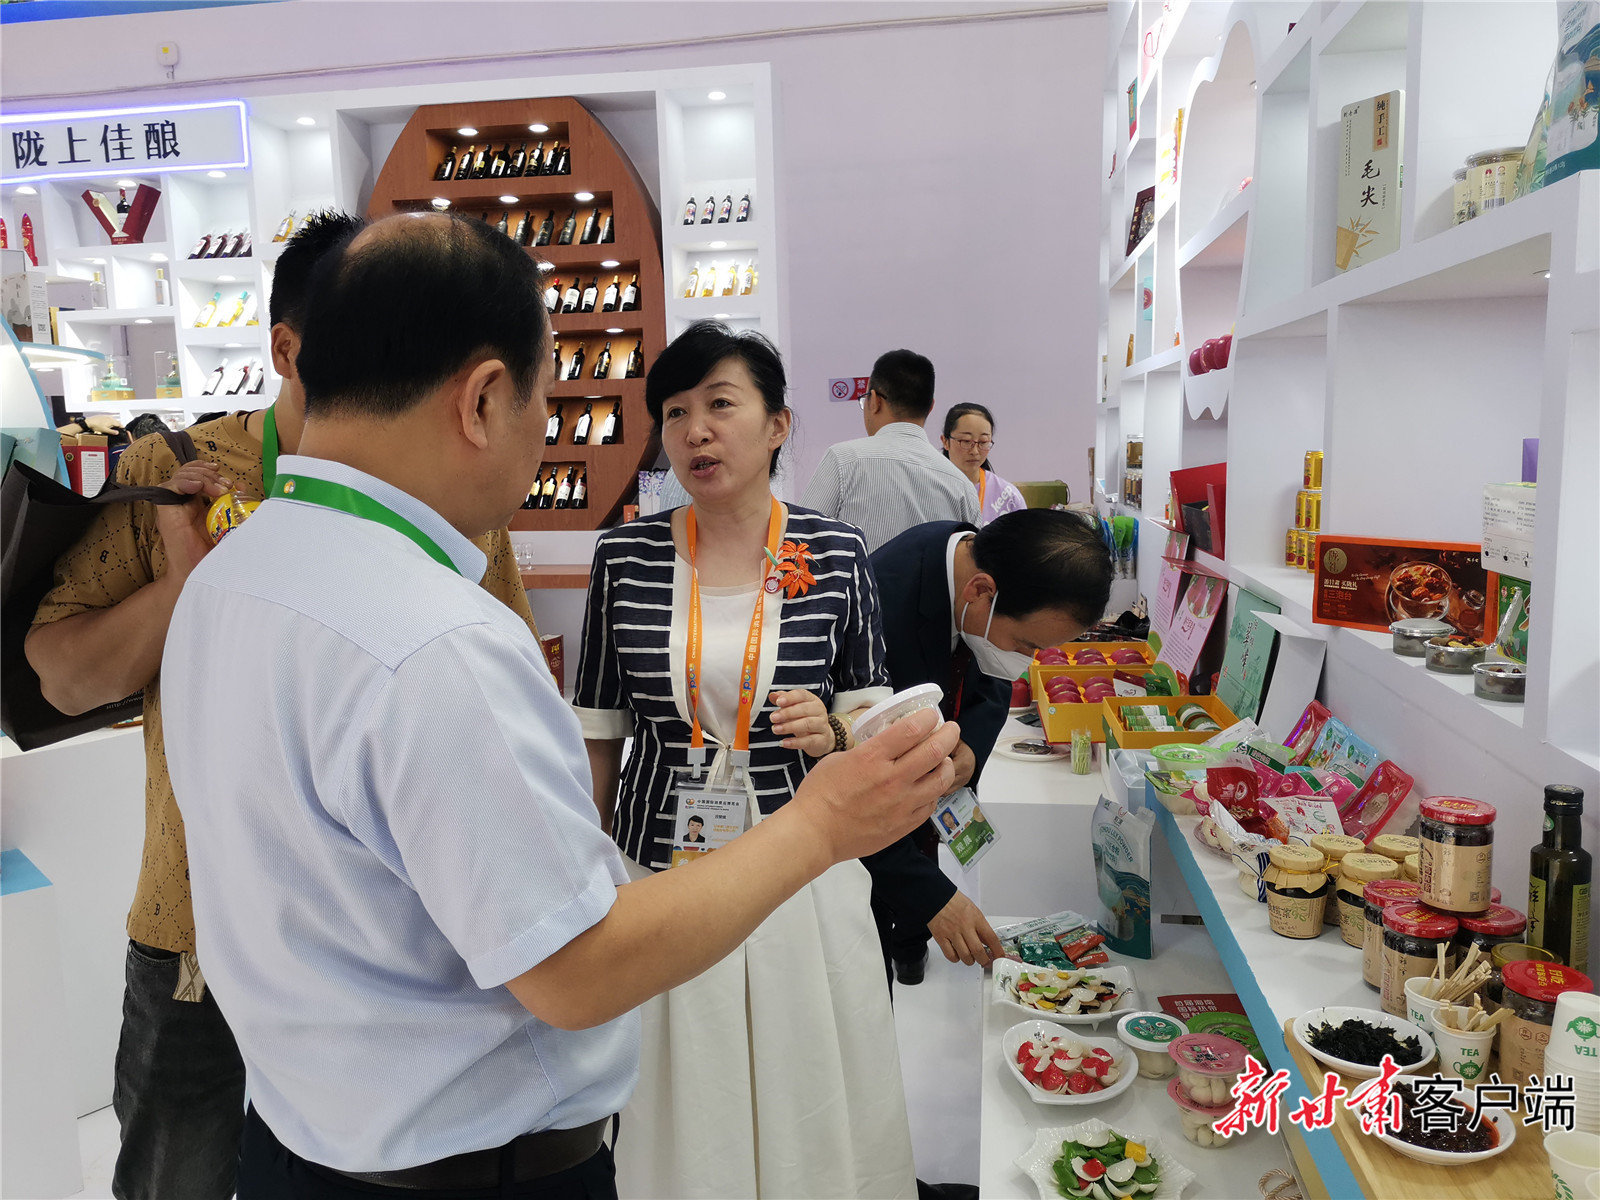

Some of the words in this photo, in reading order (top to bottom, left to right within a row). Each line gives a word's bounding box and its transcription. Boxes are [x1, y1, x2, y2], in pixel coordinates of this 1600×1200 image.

[12, 120, 181, 169] 陇上佳酿
[1360, 159, 1381, 208] 毛尖
[990, 485, 1014, 514] keep
[1410, 1008, 1425, 1022] TEA
[1460, 1047, 1480, 1057] TEA
[1574, 1044, 1599, 1058] TEA
